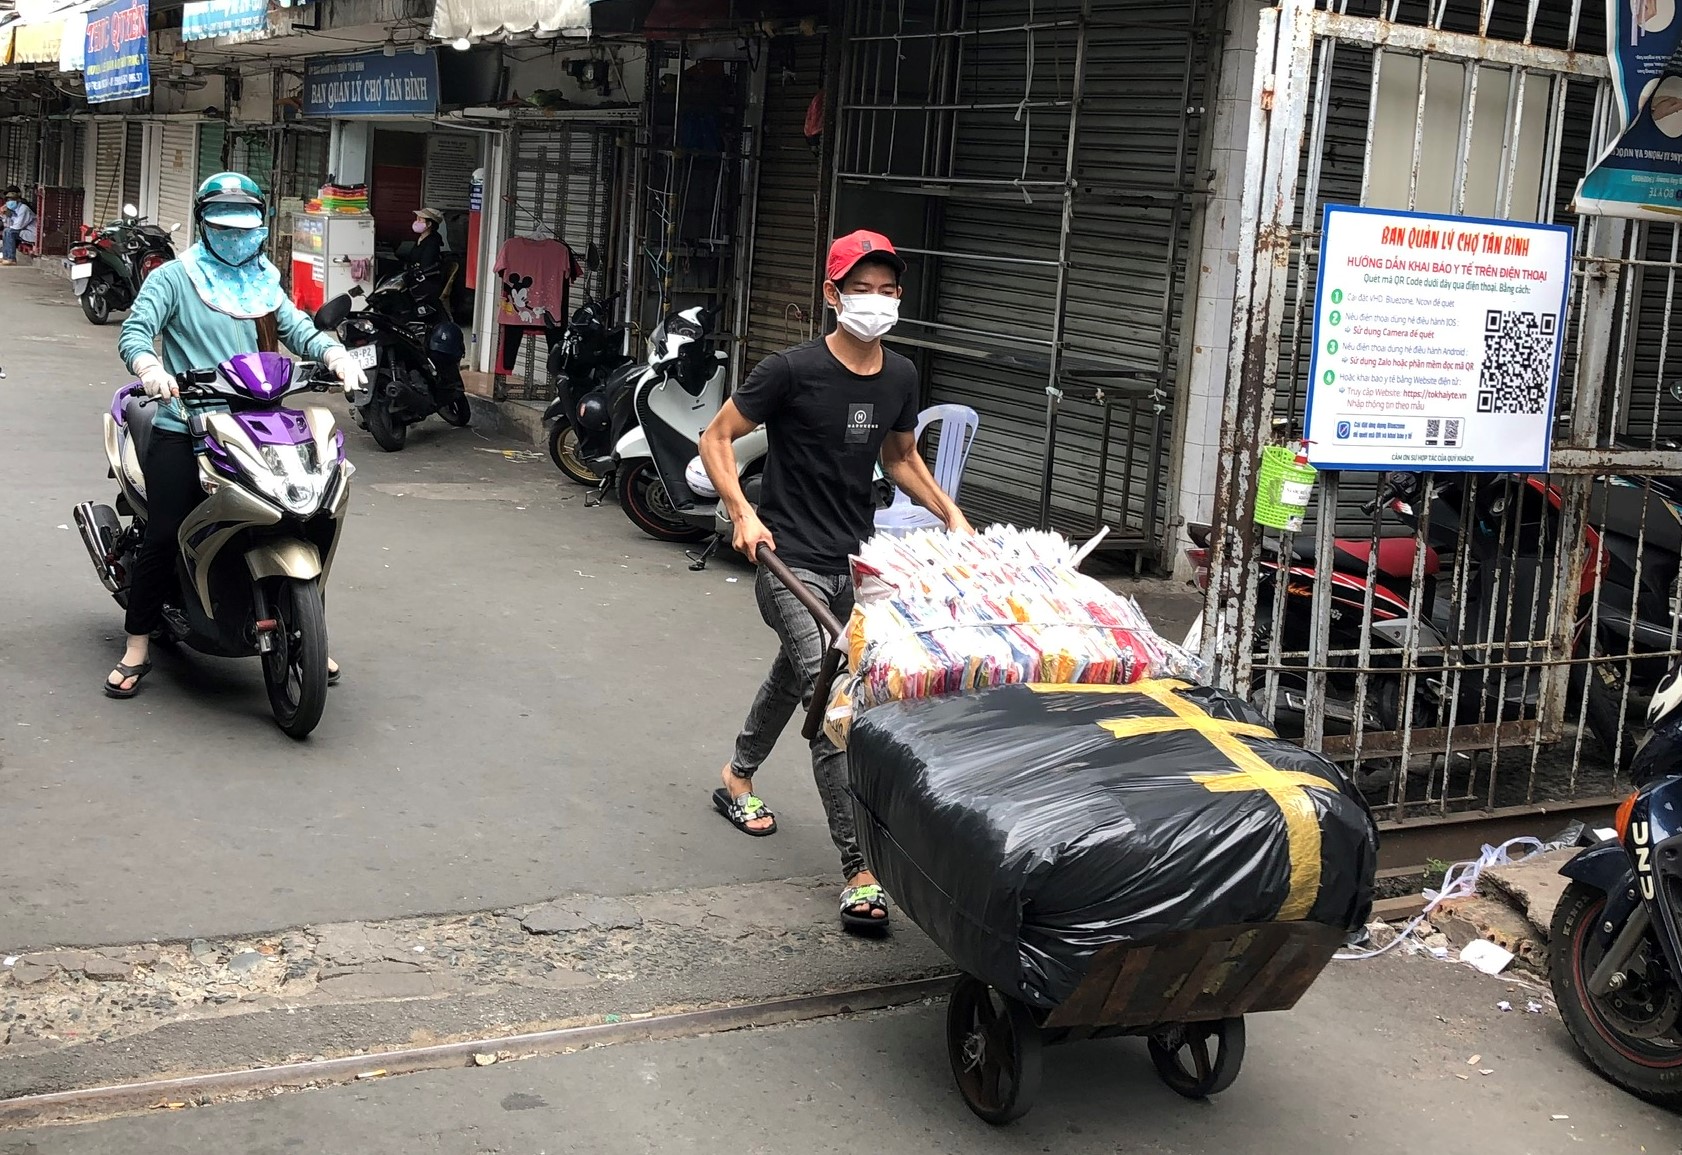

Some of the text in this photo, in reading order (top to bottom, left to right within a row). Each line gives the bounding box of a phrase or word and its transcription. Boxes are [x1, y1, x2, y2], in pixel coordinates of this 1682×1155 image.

[311, 83, 326, 104] BAN
[351, 74, 362, 102] LÝ
[364, 75, 382, 107] CHỢ
[384, 72, 402, 101] TÂN
[404, 71, 428, 101] BÌNH
[1381, 224, 1530, 256] BAN QUẢN LÝ CHỢ TÂN BÌNH
[1347, 255, 1548, 283] HƯỚNG DẪN KHAI BÁO Y TẾ TRÊN ĐIỆN THOẠI
[1364, 274, 1380, 284] Quét
[1394, 276, 1404, 286] QR
[1406, 276, 1422, 286] Code
[1452, 282, 1464, 291] qua
[1382, 328, 1408, 337] Camera
[1378, 358, 1392, 366] Zalo
[1465, 362, 1474, 372] QR
